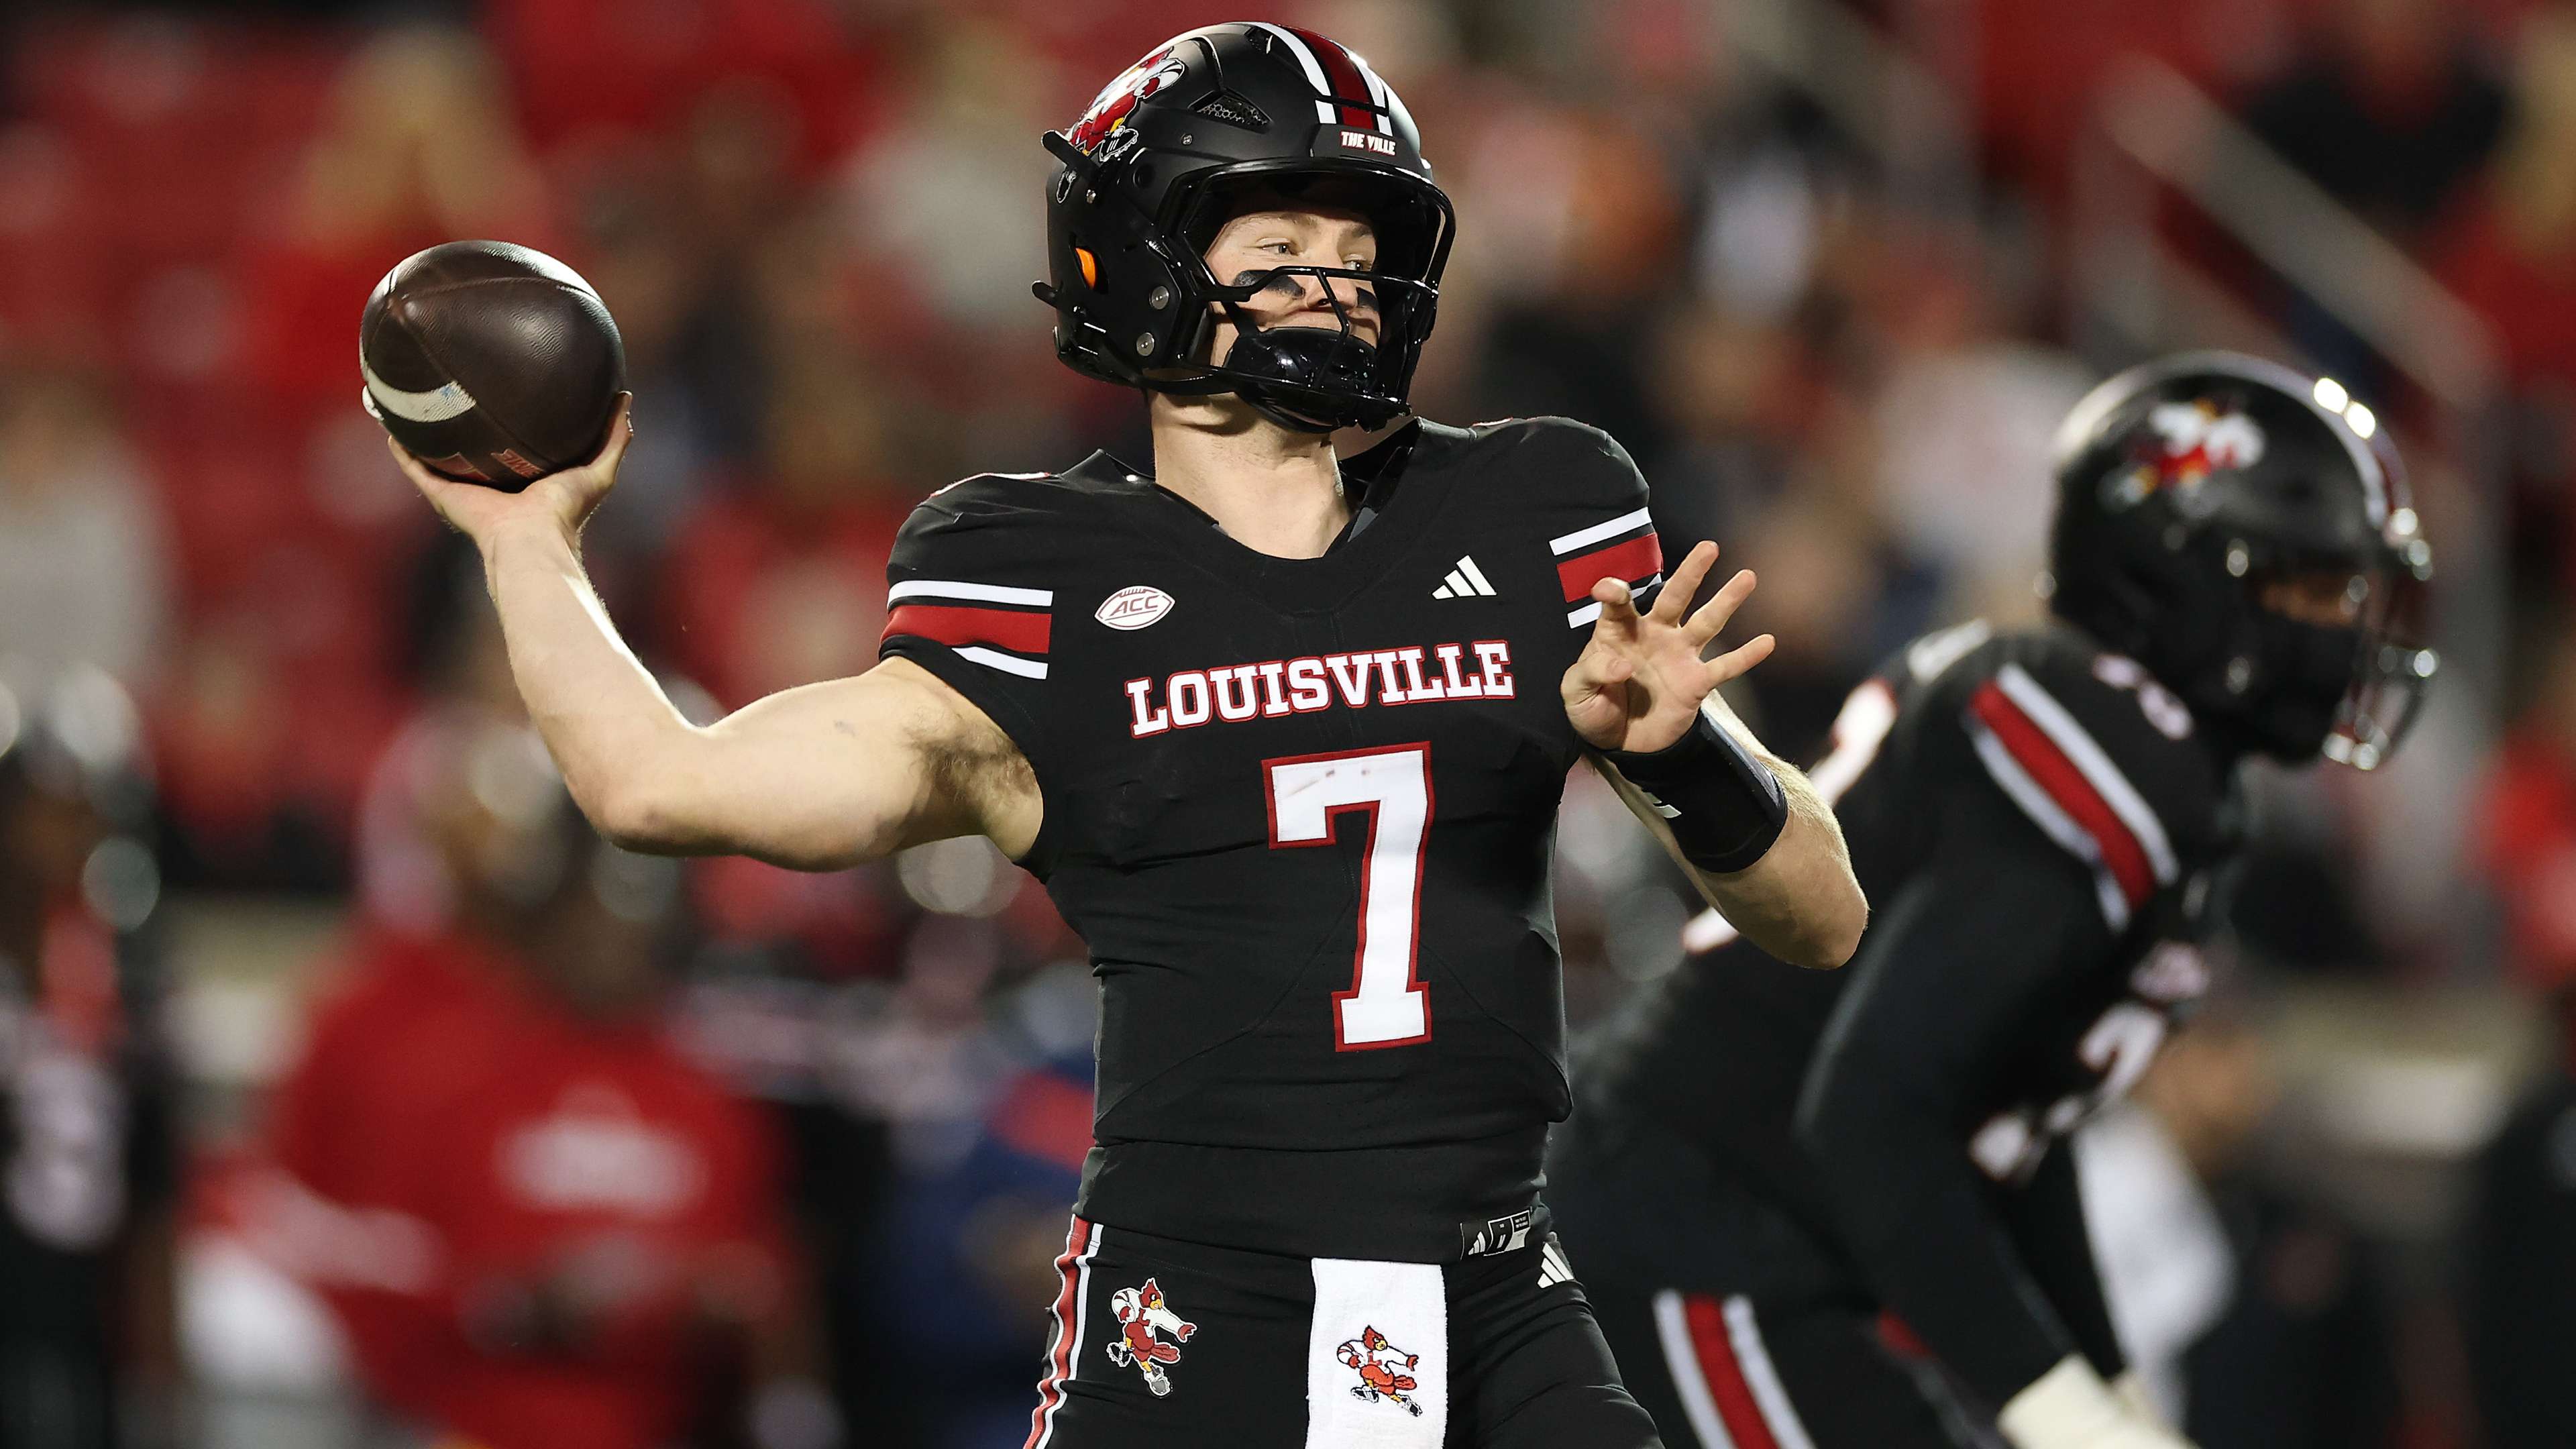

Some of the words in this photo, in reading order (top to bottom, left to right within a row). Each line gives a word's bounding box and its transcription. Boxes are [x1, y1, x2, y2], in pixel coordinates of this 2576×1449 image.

[1340, 131, 1365, 148] THE
[1366, 135, 1396, 156] VILLE
[1109, 594, 1160, 616] ACC
[1125, 639, 1516, 738] LOUISVILLE
[1261, 741, 1435, 1053] 7
